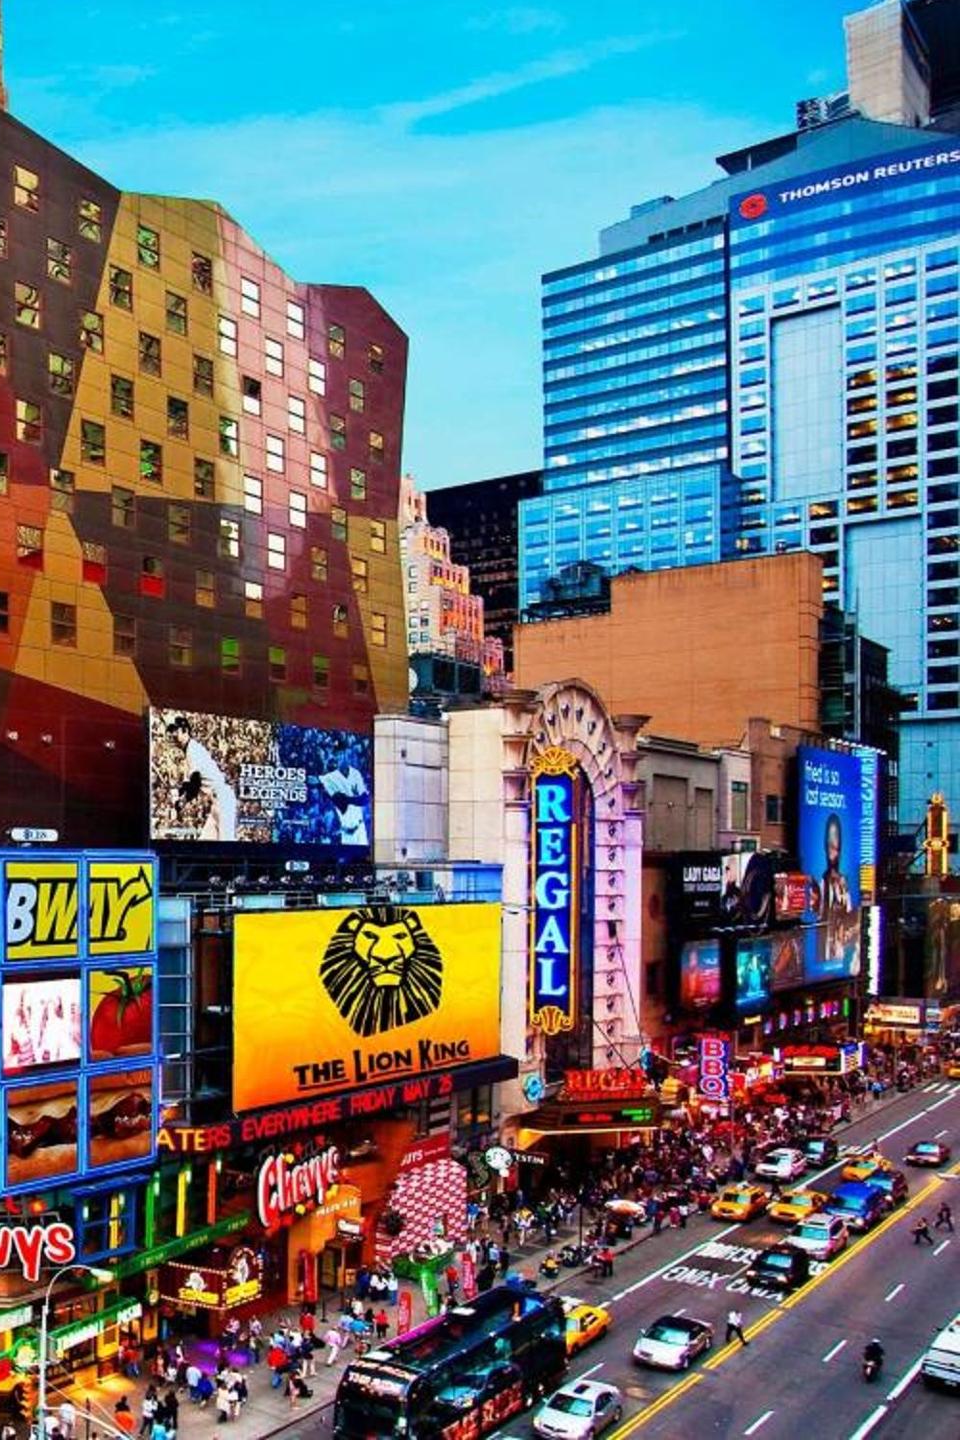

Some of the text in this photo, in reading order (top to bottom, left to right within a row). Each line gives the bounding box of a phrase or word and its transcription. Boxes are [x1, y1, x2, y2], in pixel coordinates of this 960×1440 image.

[778, 150, 960, 203] THOMSON REUTERS
[240, 764, 306, 782] HEROES
[240, 786, 307, 802] LEGENDS
[535, 784, 571, 996] REGAL
[293, 1059, 346, 1087] THE
[699, 1038, 725, 1099] BBQ
[242, 1100, 341, 1142] EVERYWHERE
[351, 1086, 395, 1116] FRIDAY
[403, 1079, 430, 1104] MAY
[258, 1146, 340, 1228] Chevys
